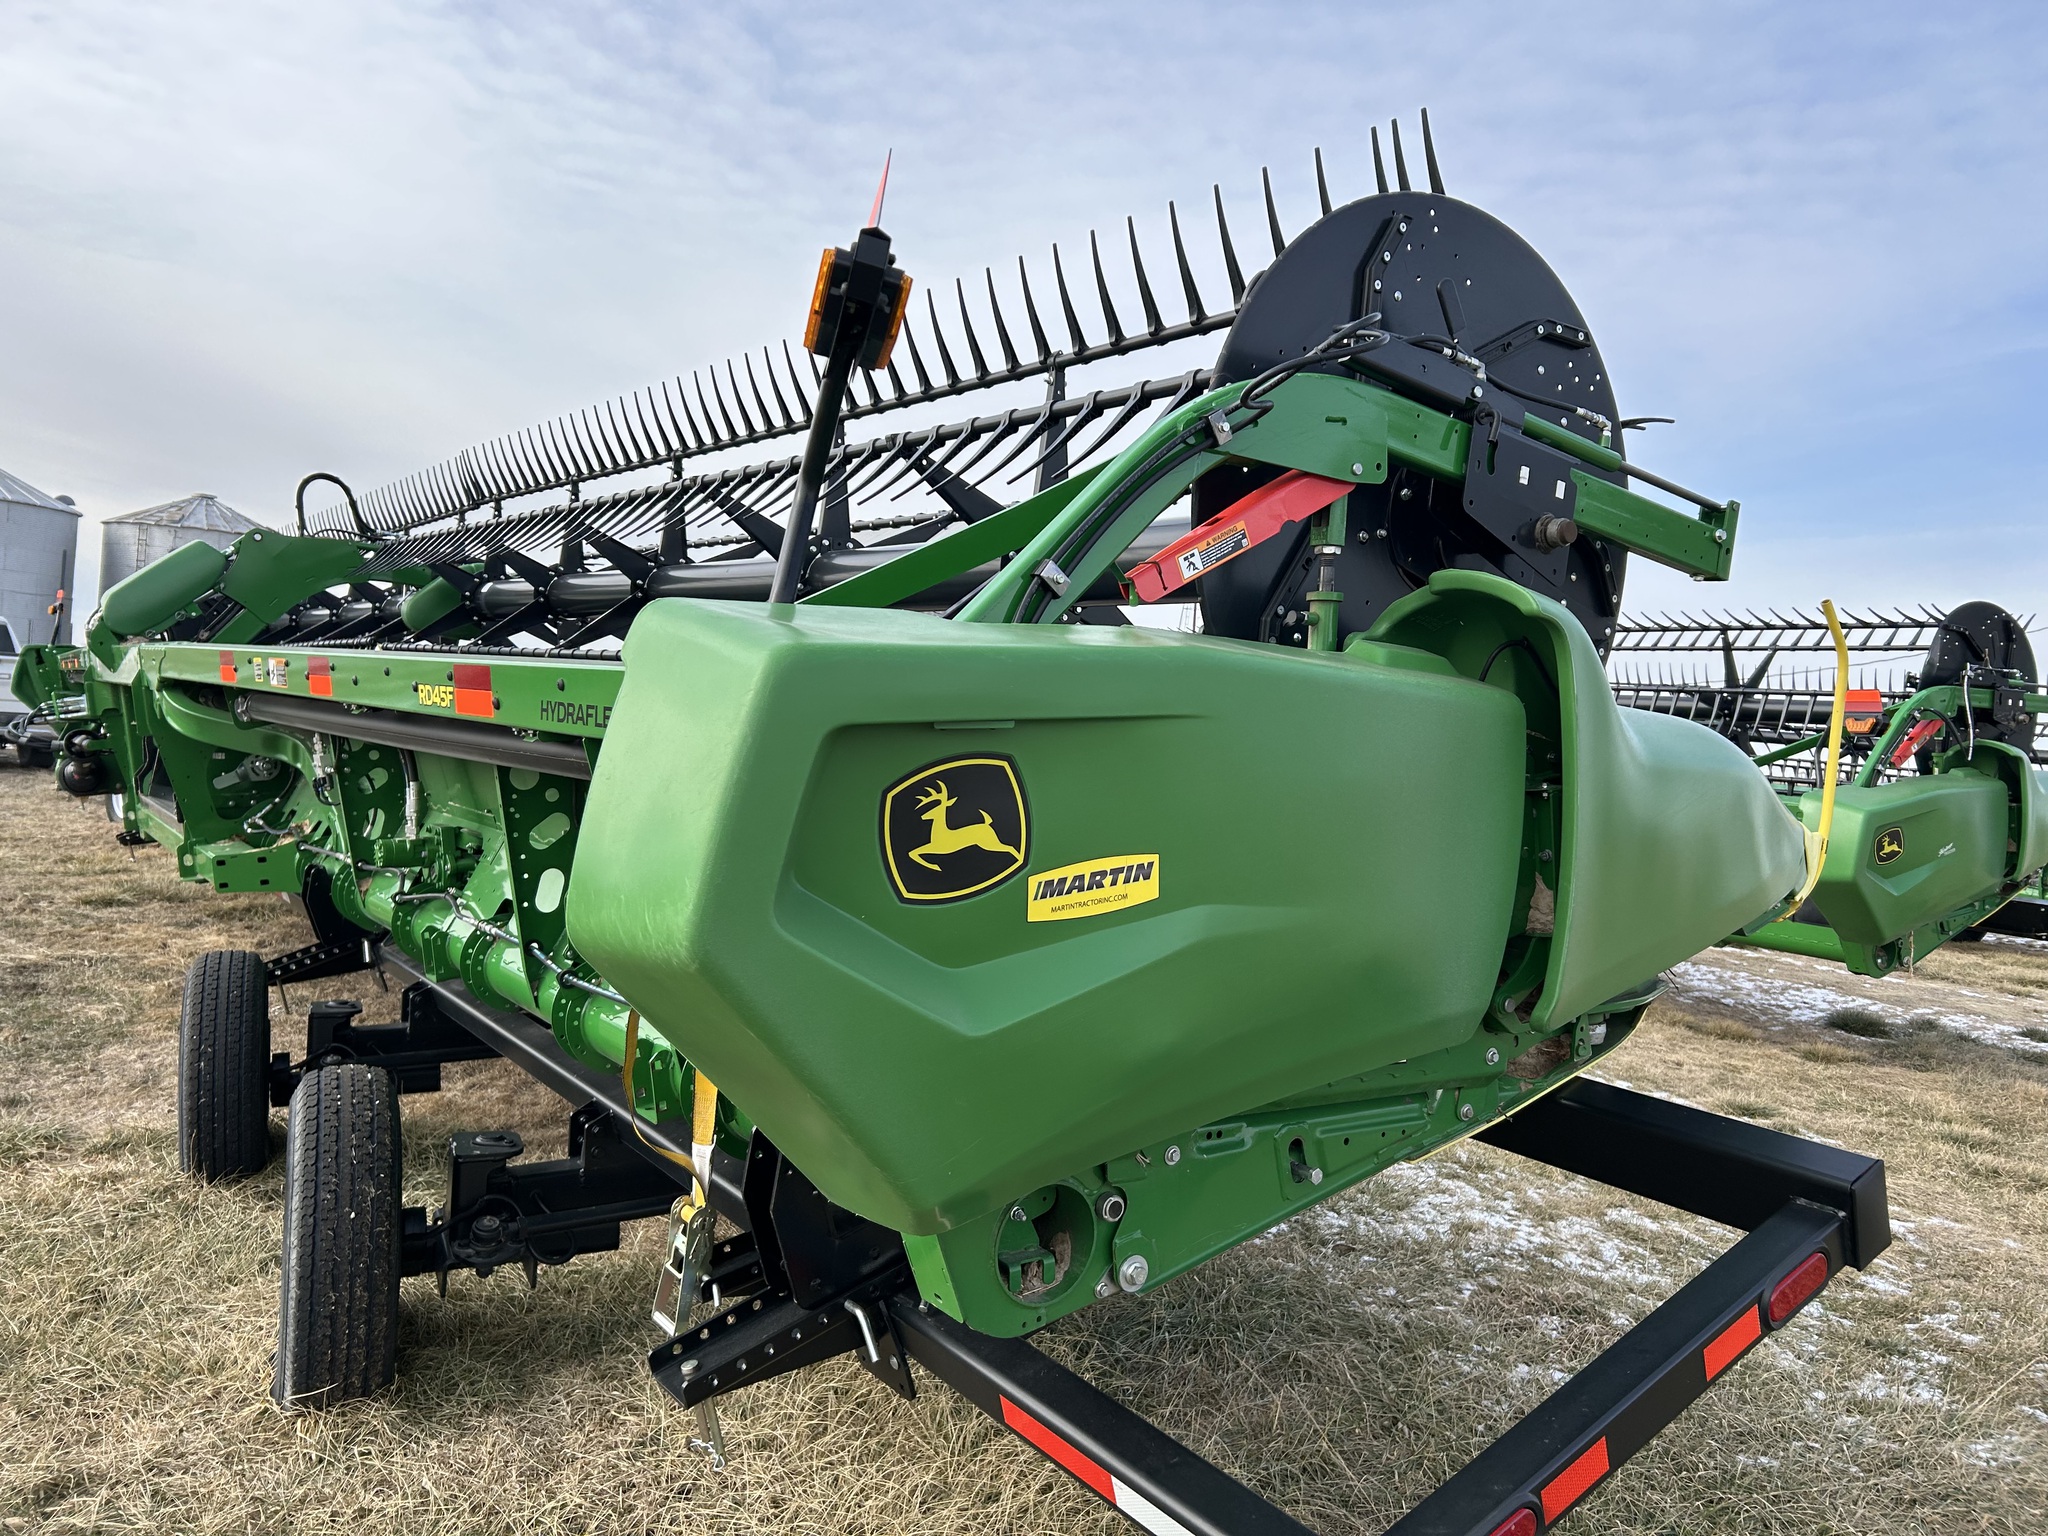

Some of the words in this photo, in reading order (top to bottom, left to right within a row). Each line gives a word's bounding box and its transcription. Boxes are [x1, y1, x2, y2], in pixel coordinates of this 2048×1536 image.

[1212, 525, 1238, 543] WARNING
[417, 683, 454, 708] RD45F
[1039, 860, 1155, 900] MARTIN
[1050, 893, 1128, 913] MARTINTRACTORINC.COM
